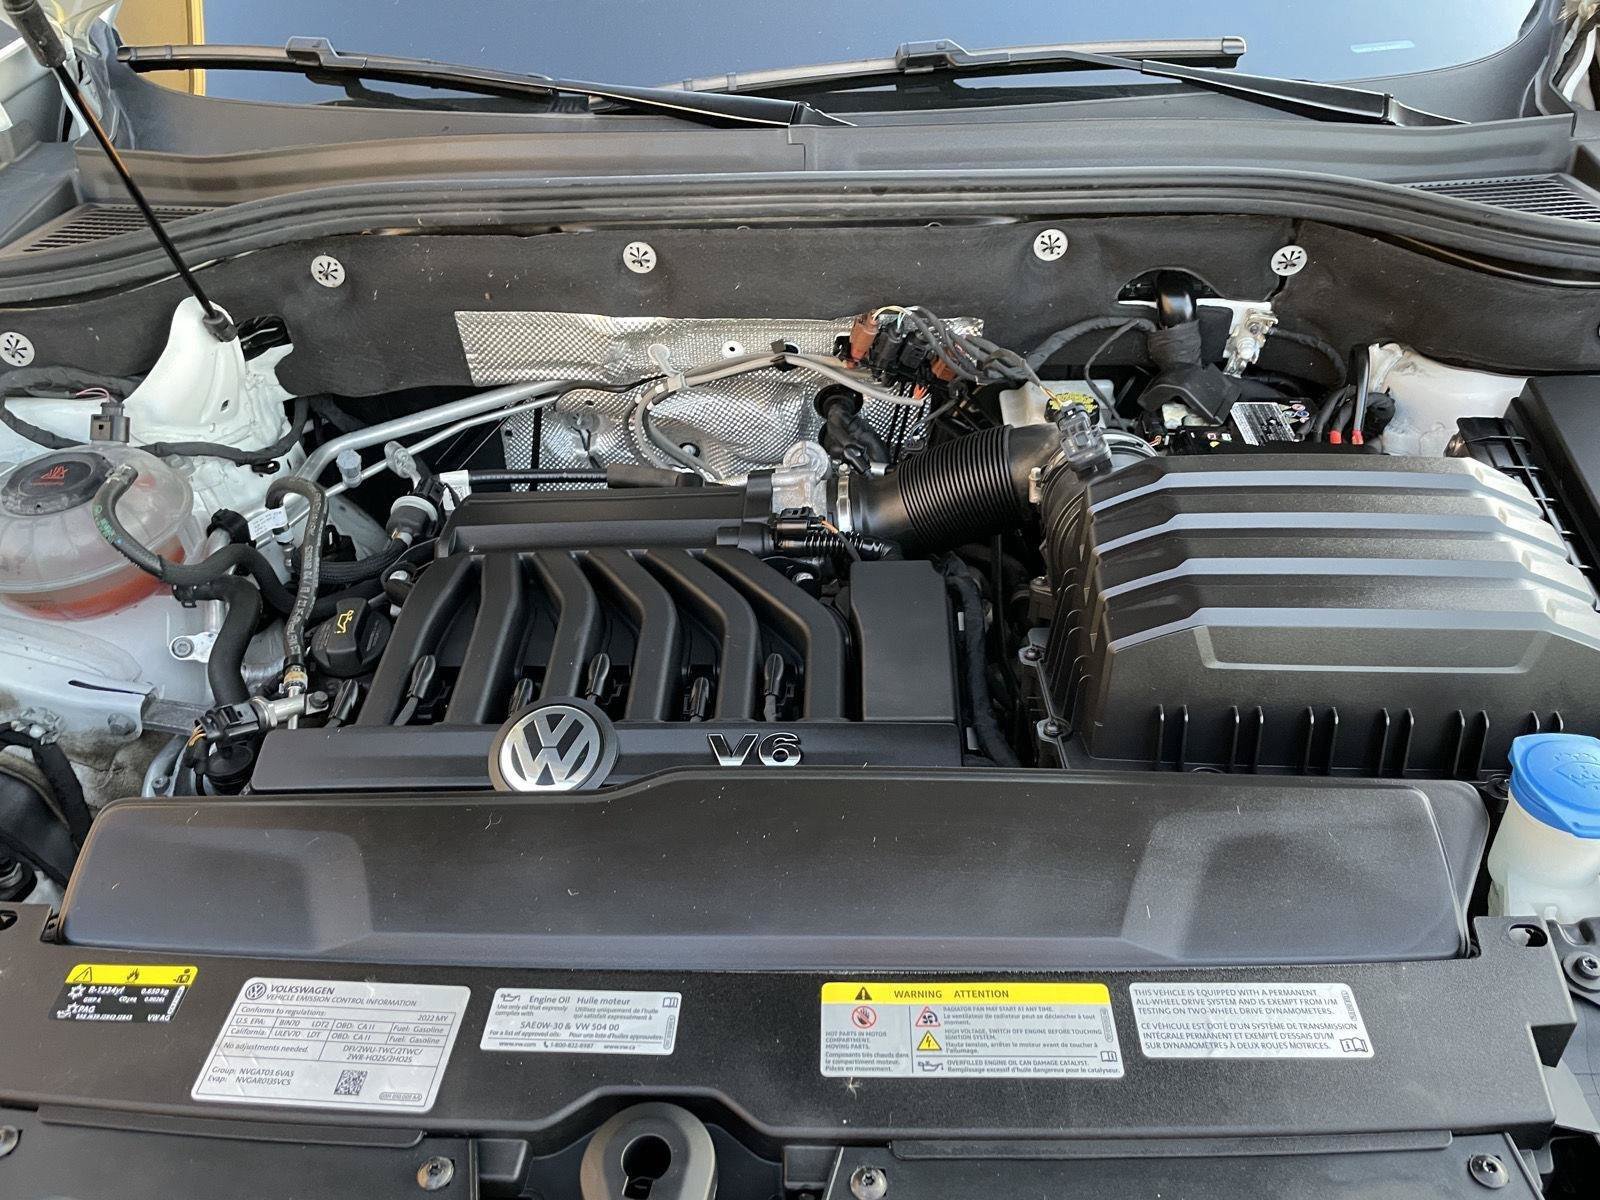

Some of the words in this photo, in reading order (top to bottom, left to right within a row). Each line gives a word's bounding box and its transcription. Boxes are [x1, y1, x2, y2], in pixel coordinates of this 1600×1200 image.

[706, 733, 802, 767] V6
[88, 986, 125, 996] R-1234yf
[270, 984, 335, 995] VOLKSWAGEN
[1196, 989, 1236, 997] EQUIPPED
[894, 990, 942, 998] WARNING
[954, 990, 1009, 998] ATTENTION
[296, 994, 331, 1002] EMISSION
[331, 996, 365, 1004] CONTROL
[366, 998, 417, 1007] INFORMATION
[529, 996, 556, 1004] Engine
[558, 996, 571, 1004] Oil
[577, 997, 598, 1005] Huile
[600, 997, 630, 1005] moteur
[241, 1006, 275, 1015] Conforms
[284, 1008, 326, 1017] regulations:
[1138, 1007, 1171, 1015] TESTING
[1265, 1007, 1335, 1015] DYNAMOMETERS.
[392, 1024, 410, 1032] Fuel:
[413, 1025, 444, 1033] Gasoline
[591, 1023, 607, 1031] 504
[231, 1028, 267, 1036] California:
[235, 1043, 279, 1051] adjustments
[212, 1066, 236, 1075] Group:
[208, 1075, 227, 1083] Evap:
